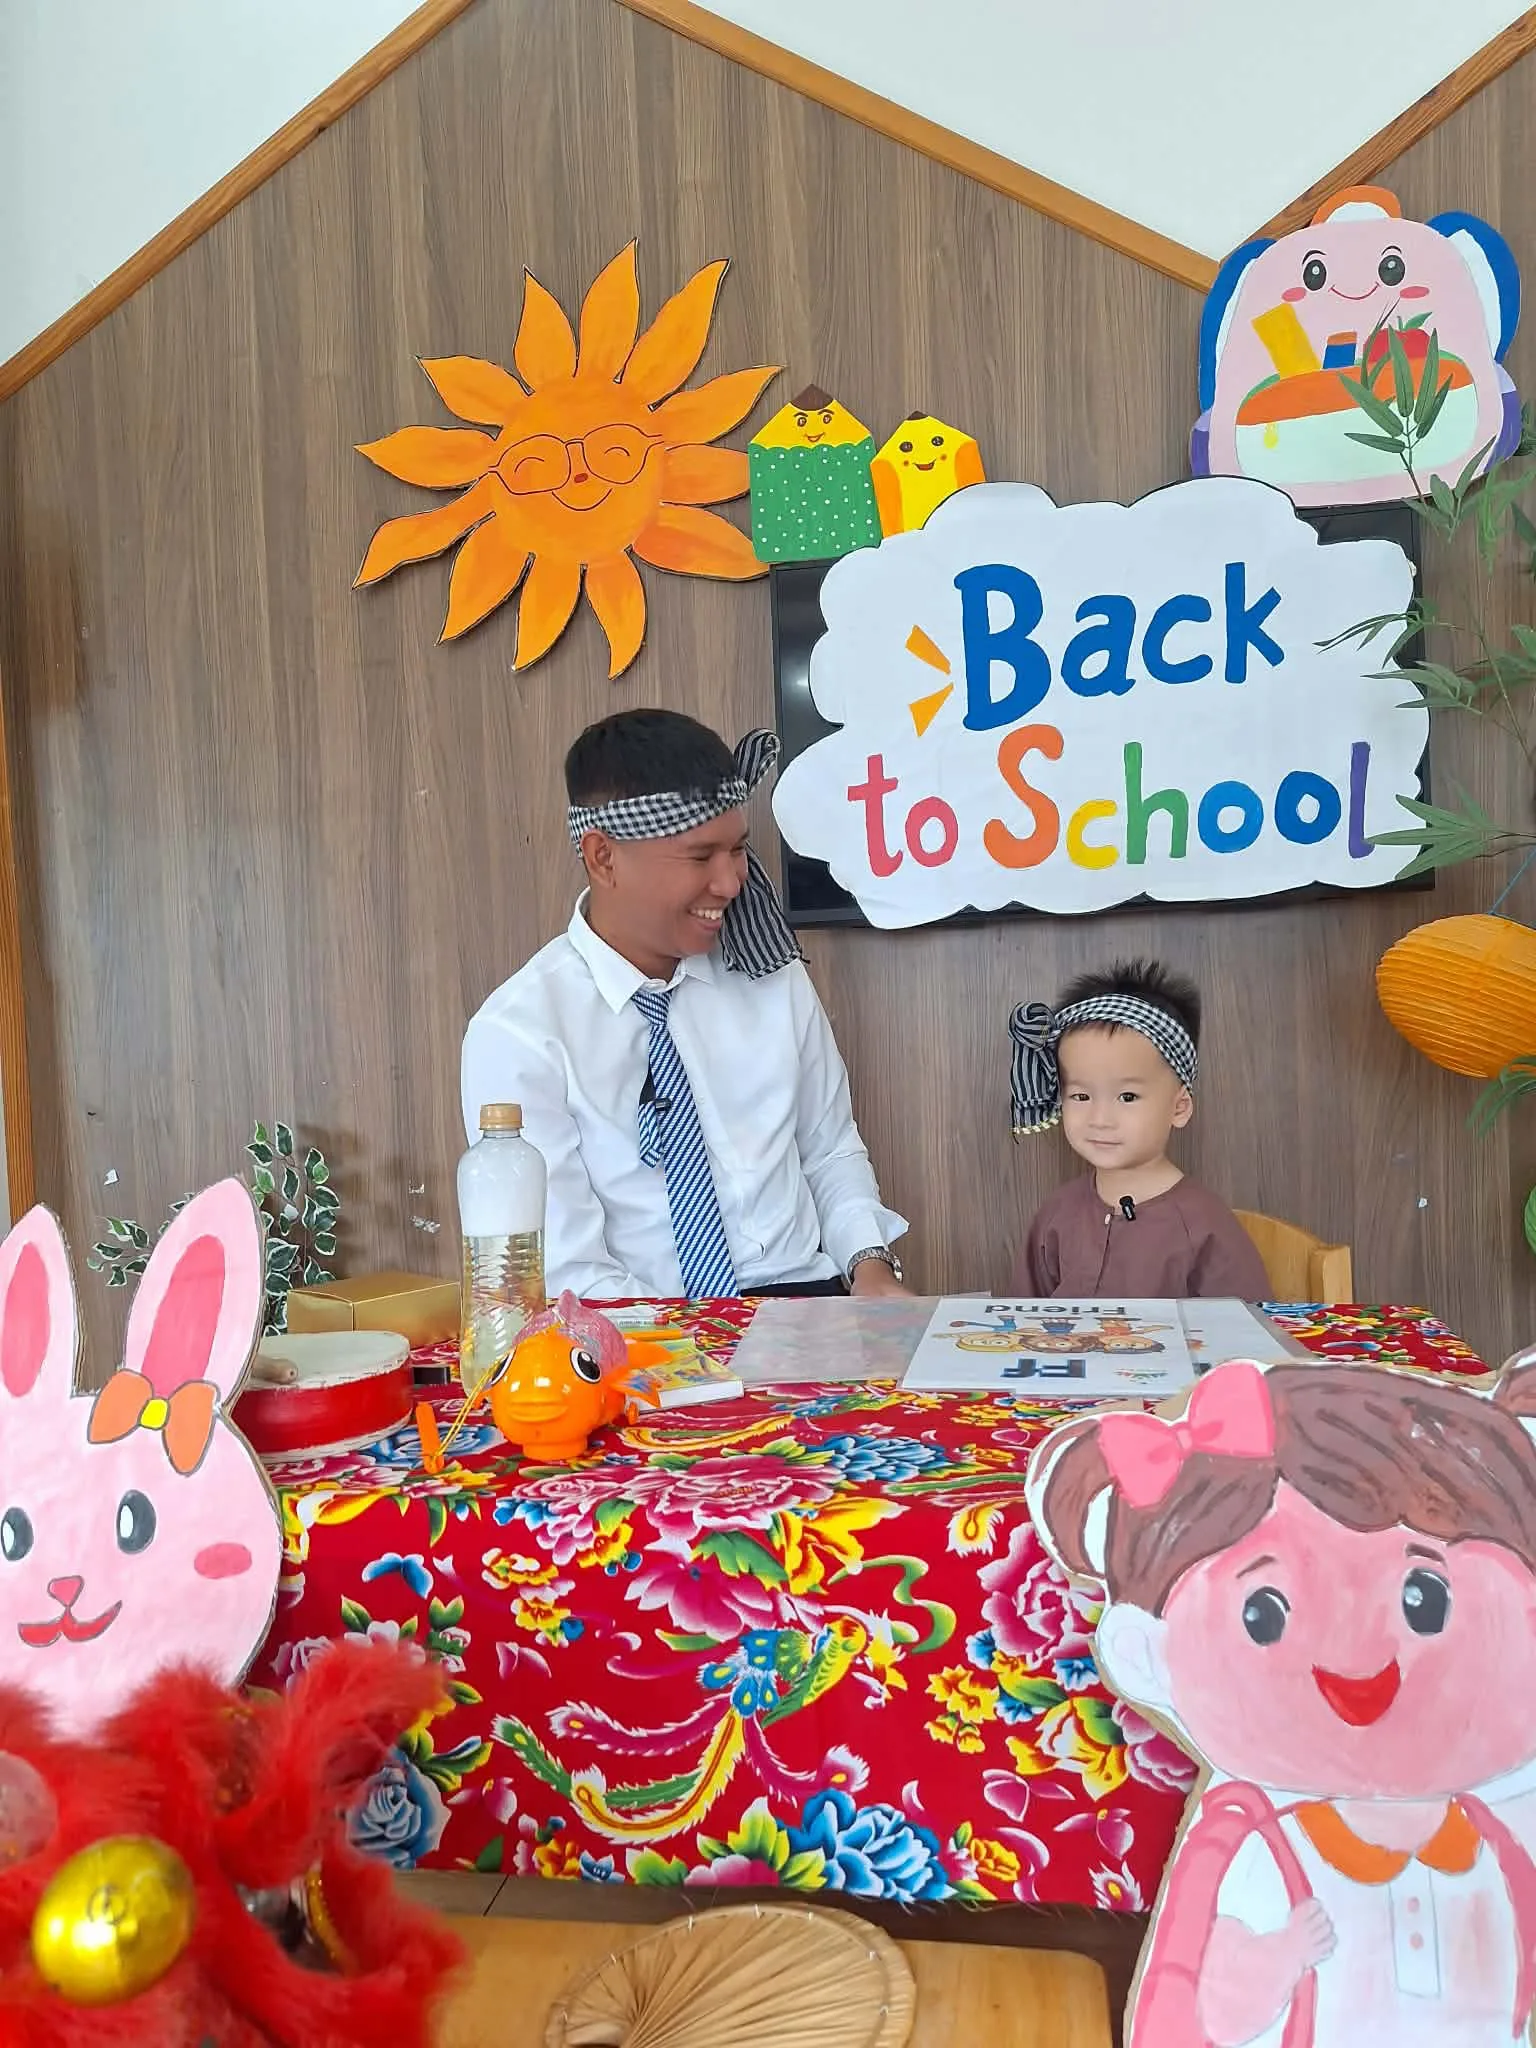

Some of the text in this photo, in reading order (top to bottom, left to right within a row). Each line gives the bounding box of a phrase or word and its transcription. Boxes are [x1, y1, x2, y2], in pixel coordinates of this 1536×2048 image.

[953, 562, 1285, 731] Back
[847, 723, 1375, 878] to School
[984, 1303, 1127, 1316] Friend
[1000, 1358, 1087, 1379] Ff
